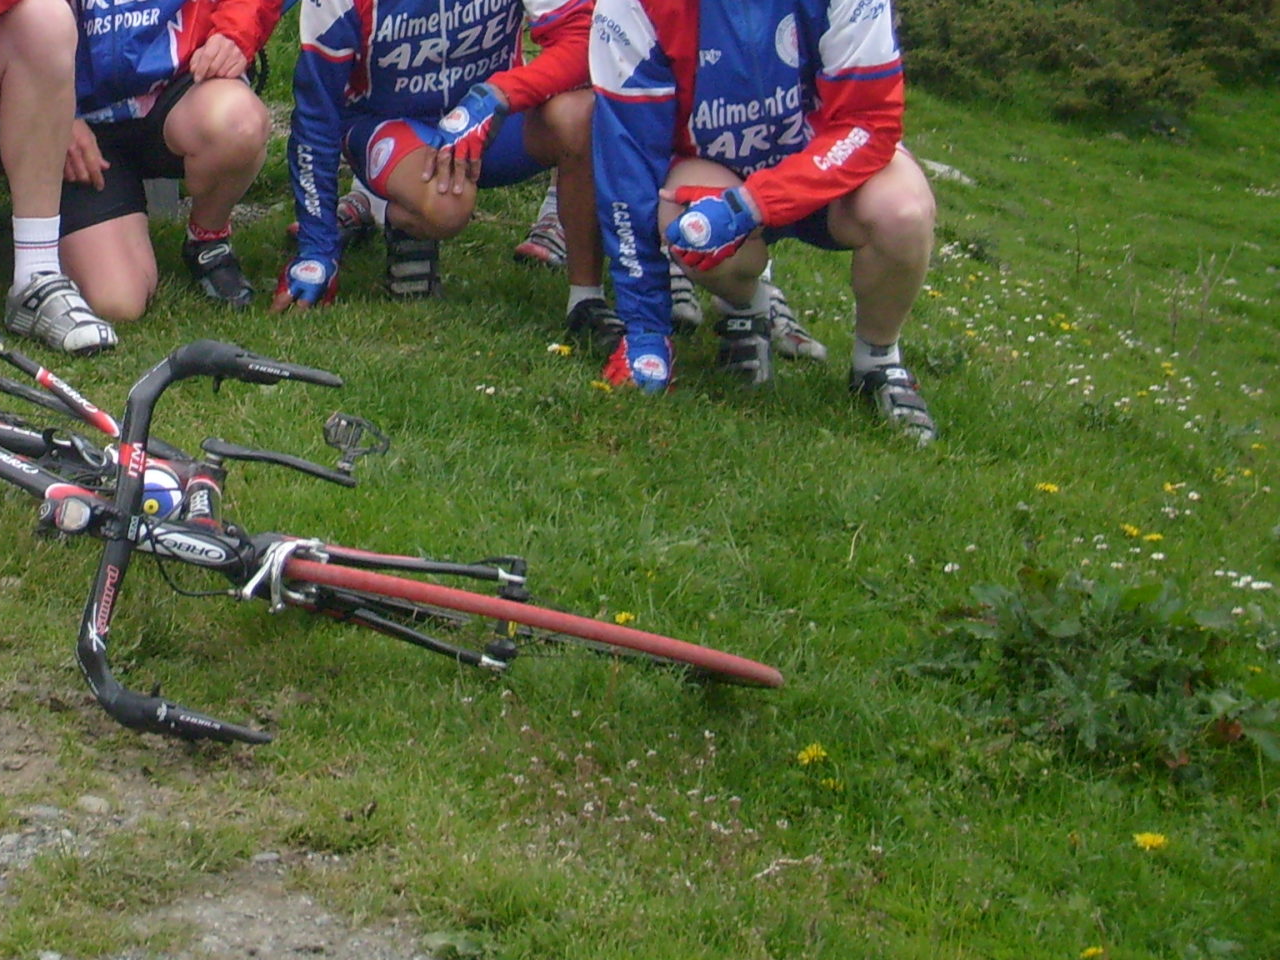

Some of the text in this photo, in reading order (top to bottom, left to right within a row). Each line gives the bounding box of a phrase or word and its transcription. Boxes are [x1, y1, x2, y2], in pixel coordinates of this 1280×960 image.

[377, 3, 518, 71] ARZEL
[394, 43, 510, 94] PORSPODER
[694, 85, 802, 130] Alimenta
[707, 113, 803, 160] ARZ
